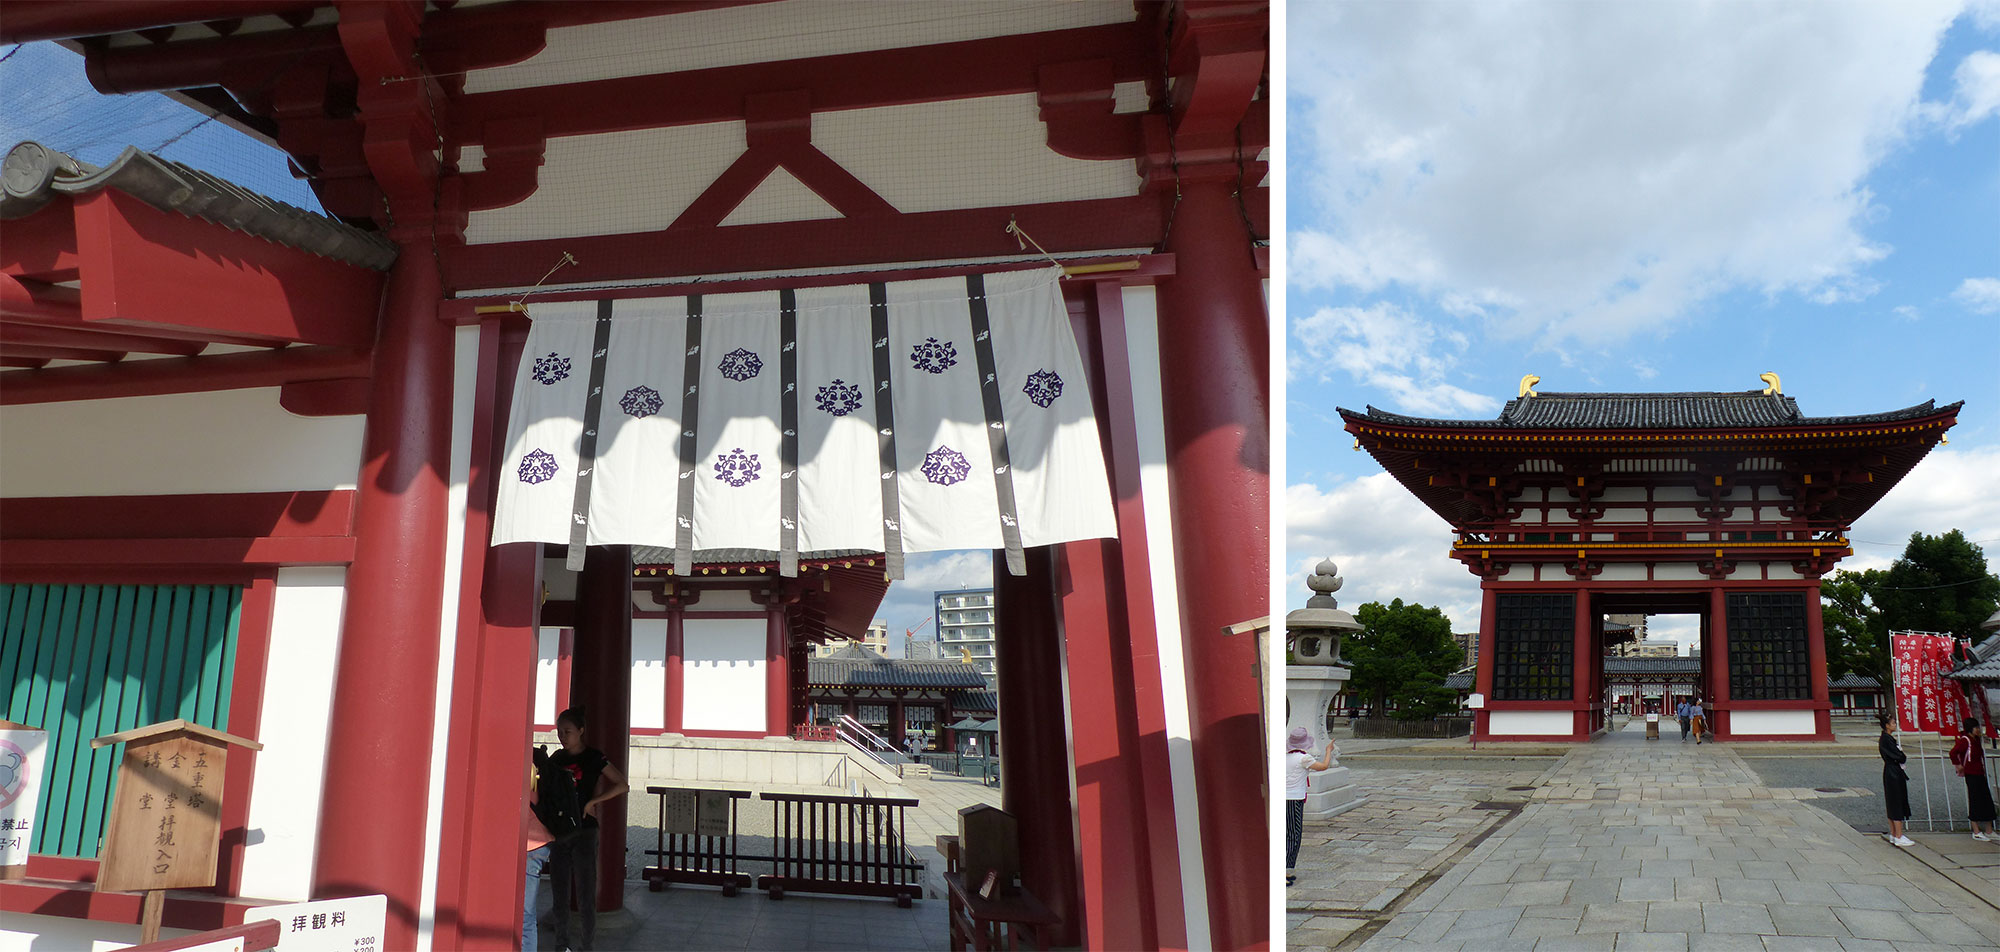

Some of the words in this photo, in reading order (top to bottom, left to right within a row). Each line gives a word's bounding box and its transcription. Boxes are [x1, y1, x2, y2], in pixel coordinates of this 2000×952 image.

[187, 750, 208, 808] 五重塔
[1, 818, 29, 831] 禁止
[291, 910, 346, 932] 拝観料
[354, 936, 376, 946] ¥300
